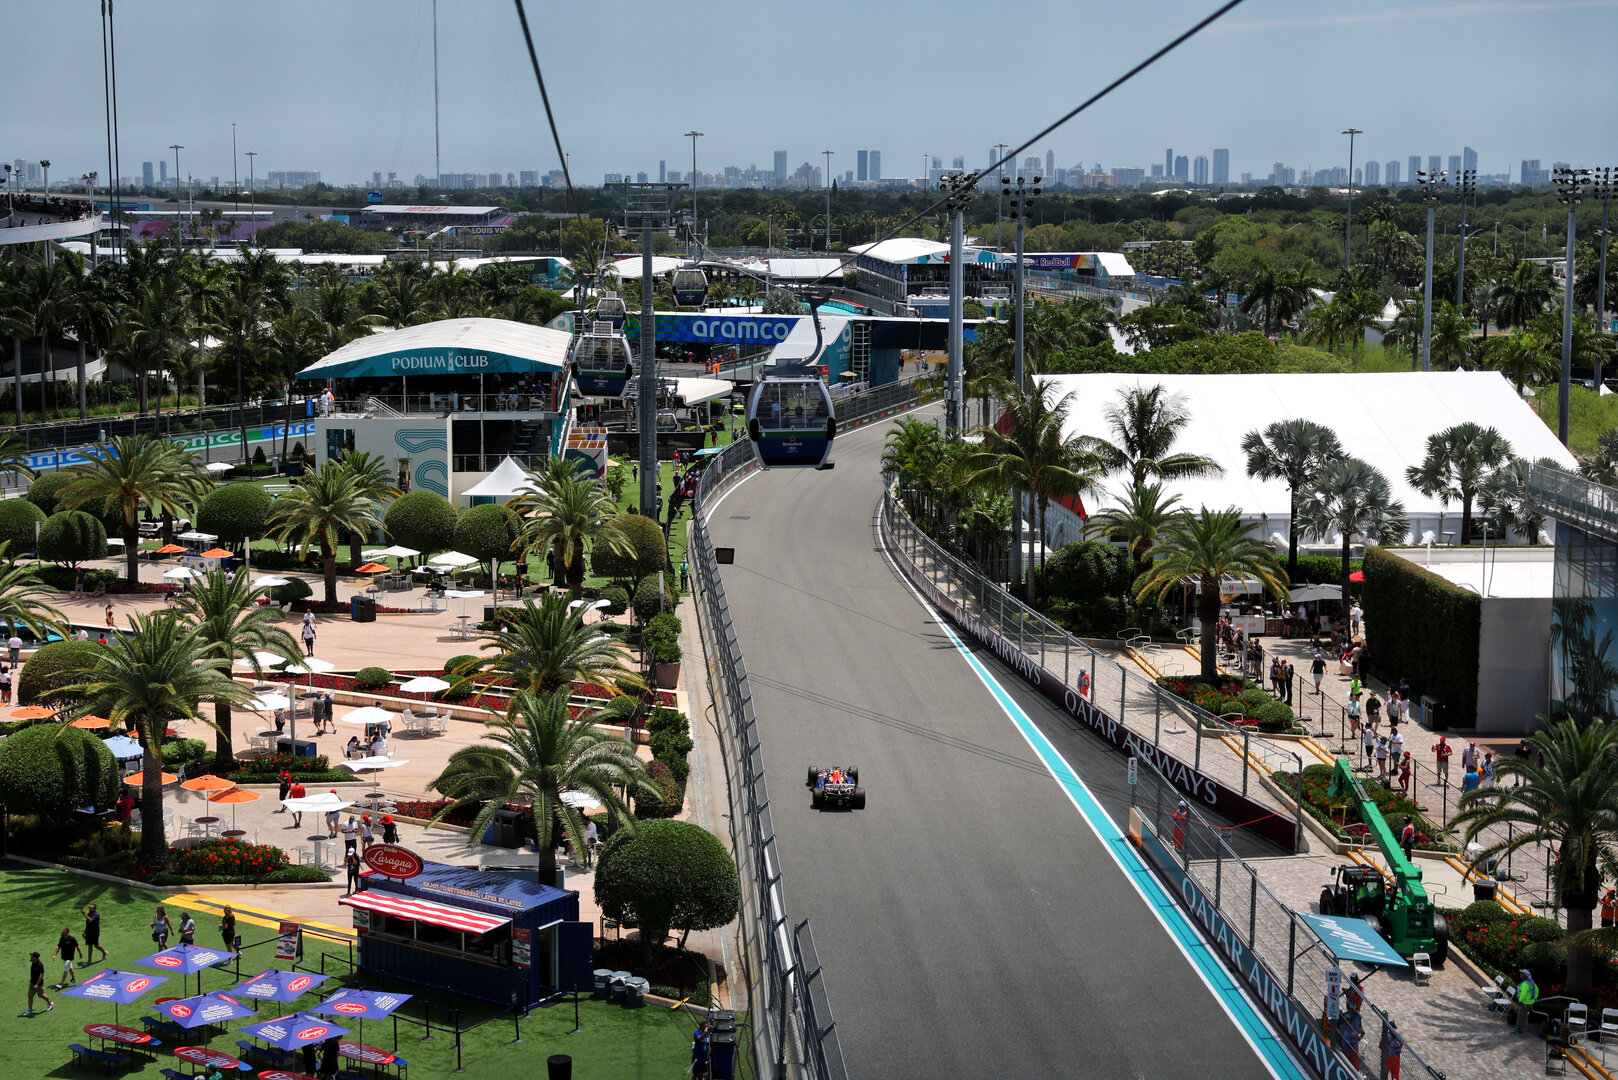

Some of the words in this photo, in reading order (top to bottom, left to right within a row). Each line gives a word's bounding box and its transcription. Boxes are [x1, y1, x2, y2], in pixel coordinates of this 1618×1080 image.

[692, 320, 789, 340] aramco
[391, 355, 446, 370] PODIUM
[455, 355, 488, 368] CLUB
[954, 606, 988, 646] QATAR
[990, 635, 1041, 685] AIRWAYS
[1064, 689, 1118, 745] QATAR
[1122, 731, 1218, 805] AIRWAYS
[369, 850, 413, 870] Lasagna
[1182, 877, 1244, 972] QATAR
